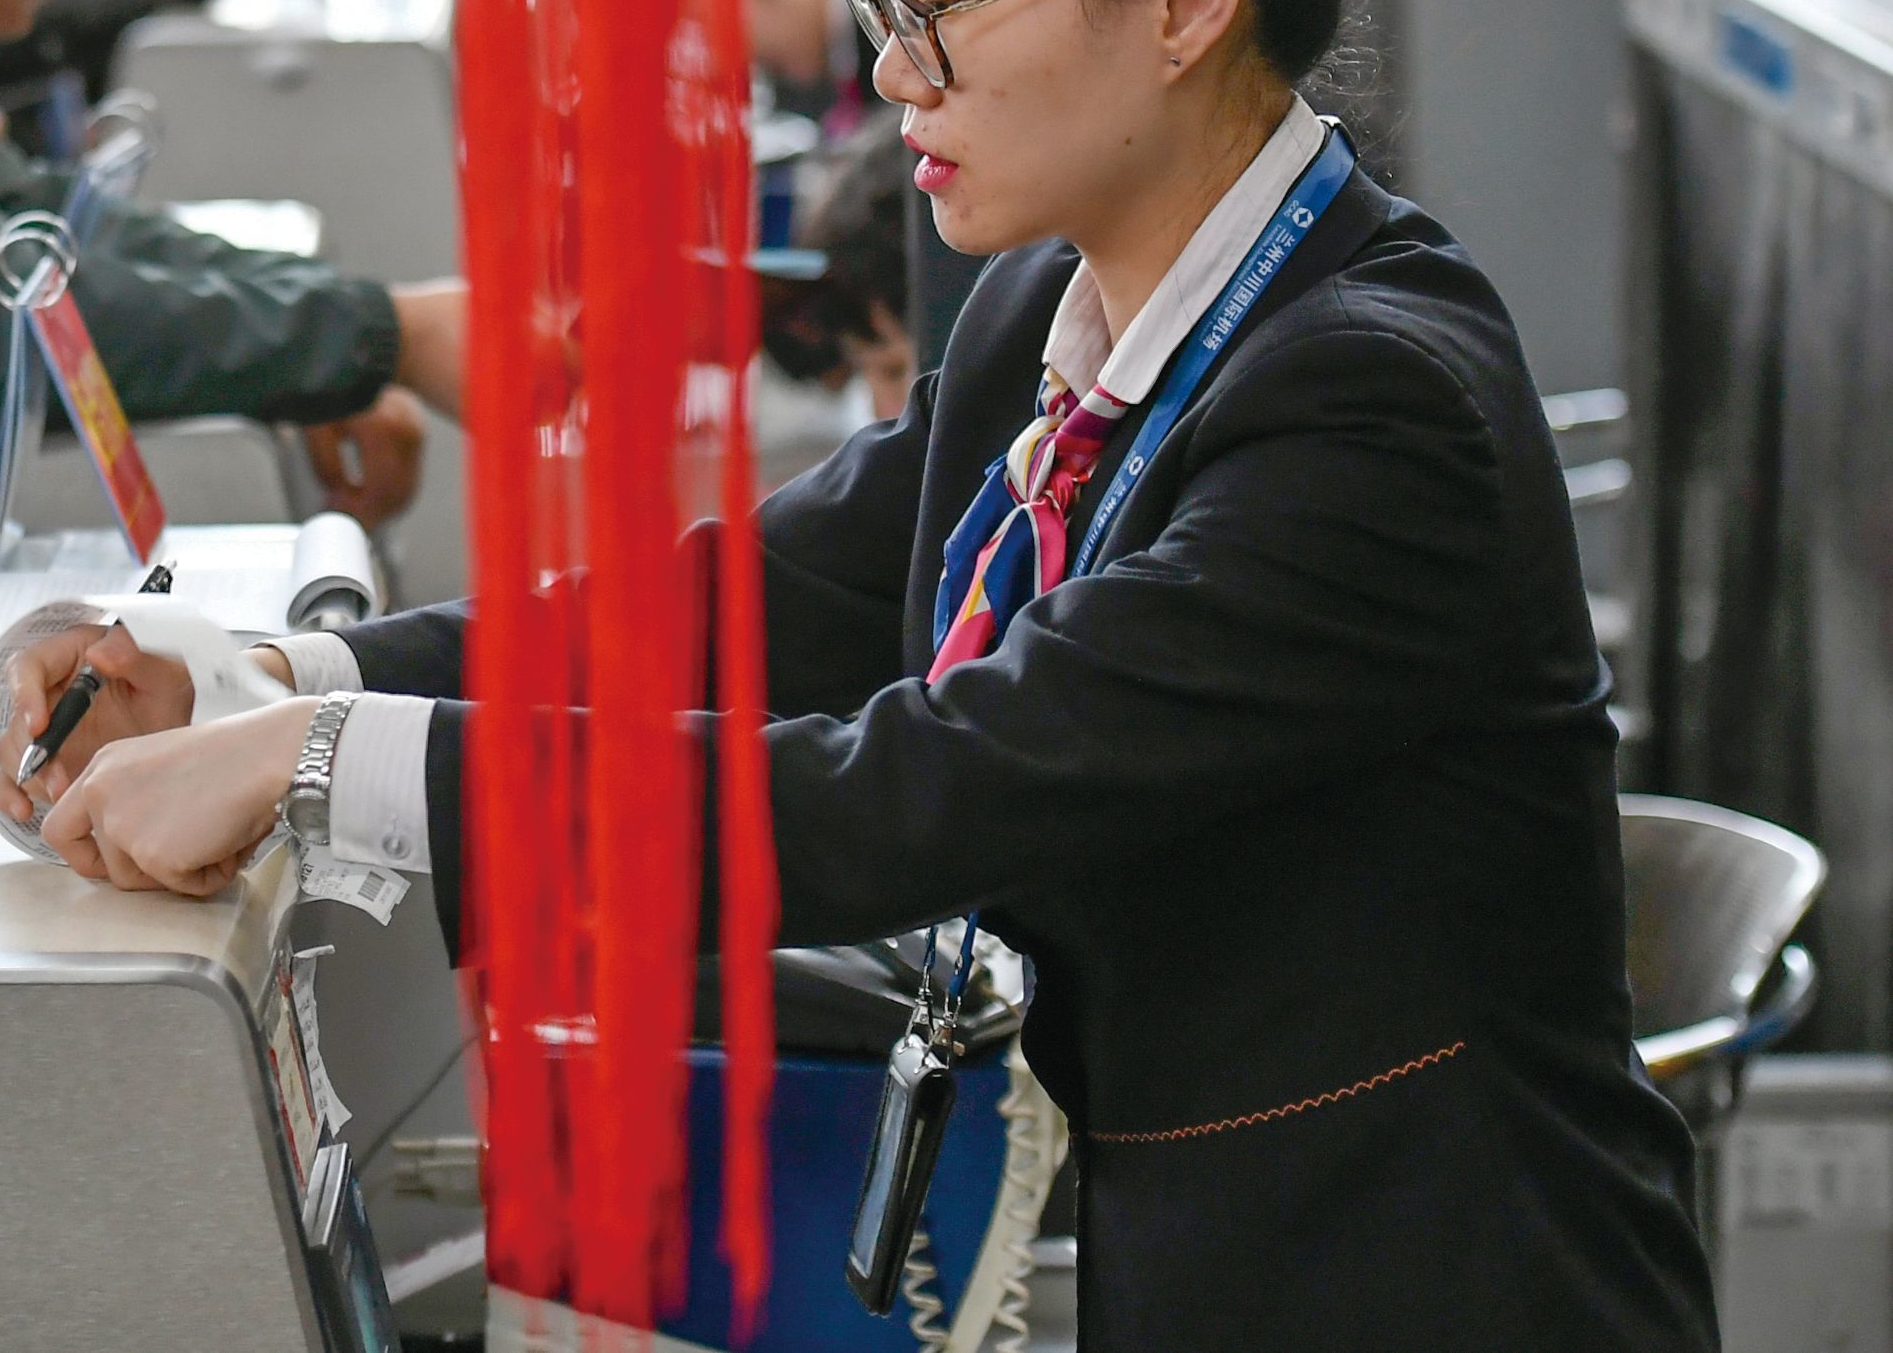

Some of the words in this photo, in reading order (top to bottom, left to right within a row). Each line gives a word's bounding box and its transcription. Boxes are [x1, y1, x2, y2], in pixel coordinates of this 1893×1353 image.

[1202, 227, 1297, 352] 兰州中川国际机场
